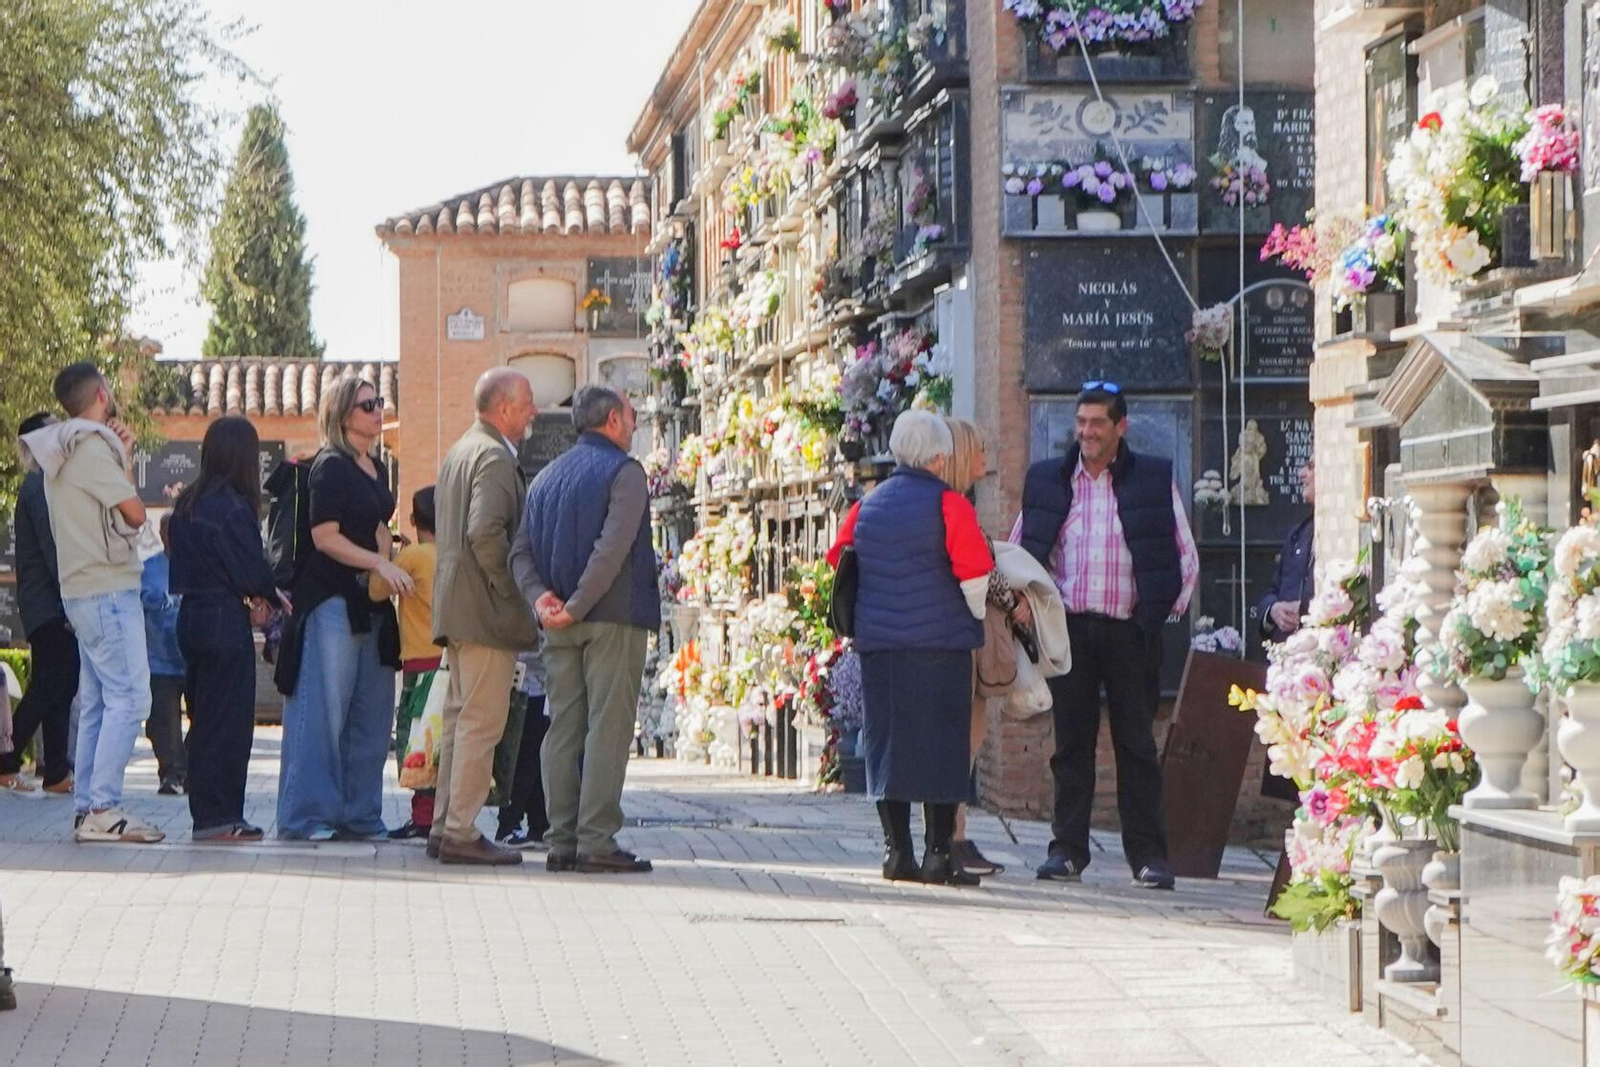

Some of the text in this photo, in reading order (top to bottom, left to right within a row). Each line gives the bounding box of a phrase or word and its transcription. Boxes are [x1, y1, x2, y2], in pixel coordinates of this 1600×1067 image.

[1078, 279, 1138, 295] NICOLÁS
[1062, 309, 1154, 327] MARÍA JESÚS
